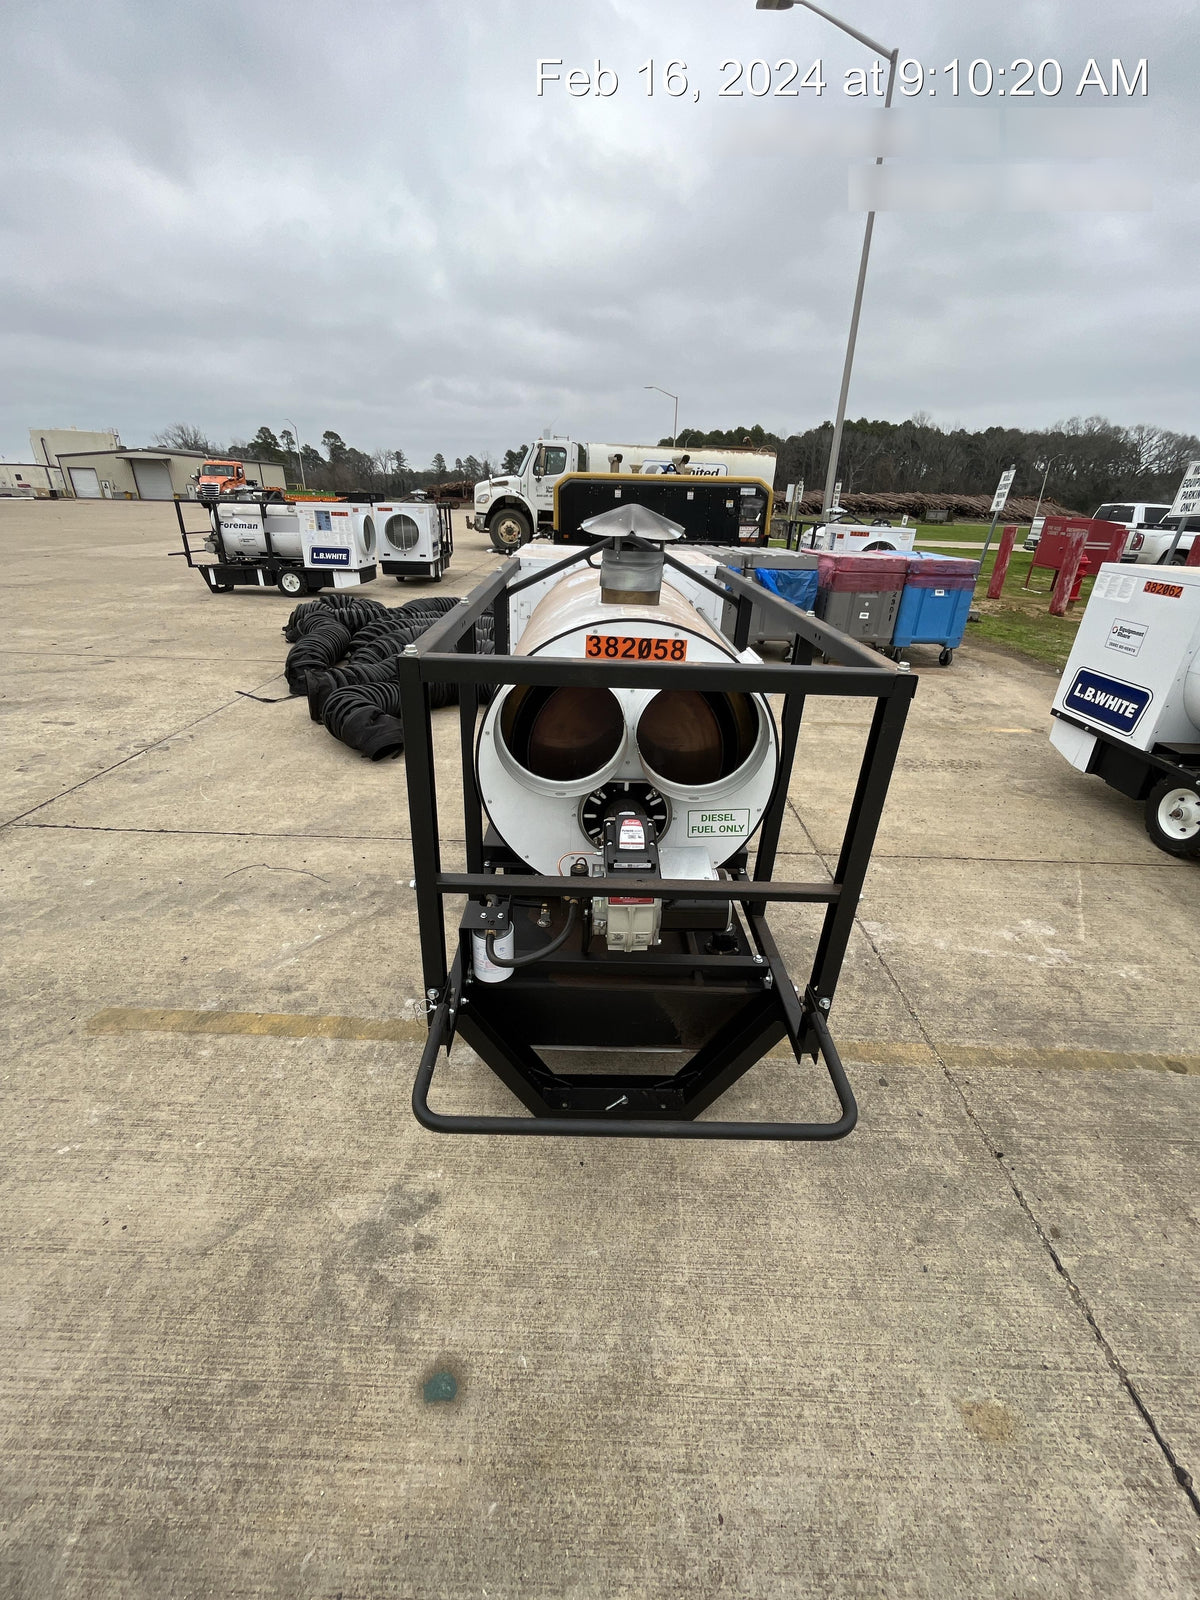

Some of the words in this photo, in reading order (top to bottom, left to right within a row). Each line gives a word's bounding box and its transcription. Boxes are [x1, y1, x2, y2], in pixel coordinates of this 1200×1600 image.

[219, 521, 258, 530] Foreman
[313, 552, 348, 560] L.B.WHITE
[1144, 581, 1183, 598] 382062
[1117, 631, 1131, 640] Share
[1119, 626, 1144, 637] Equipment
[588, 635, 684, 661] 382058
[1073, 682, 1139, 719] L.B.WHITE
[701, 813, 736, 822] DIESEL
[691, 825, 716, 834] FUEL
[718, 824, 745, 833] ONLY
